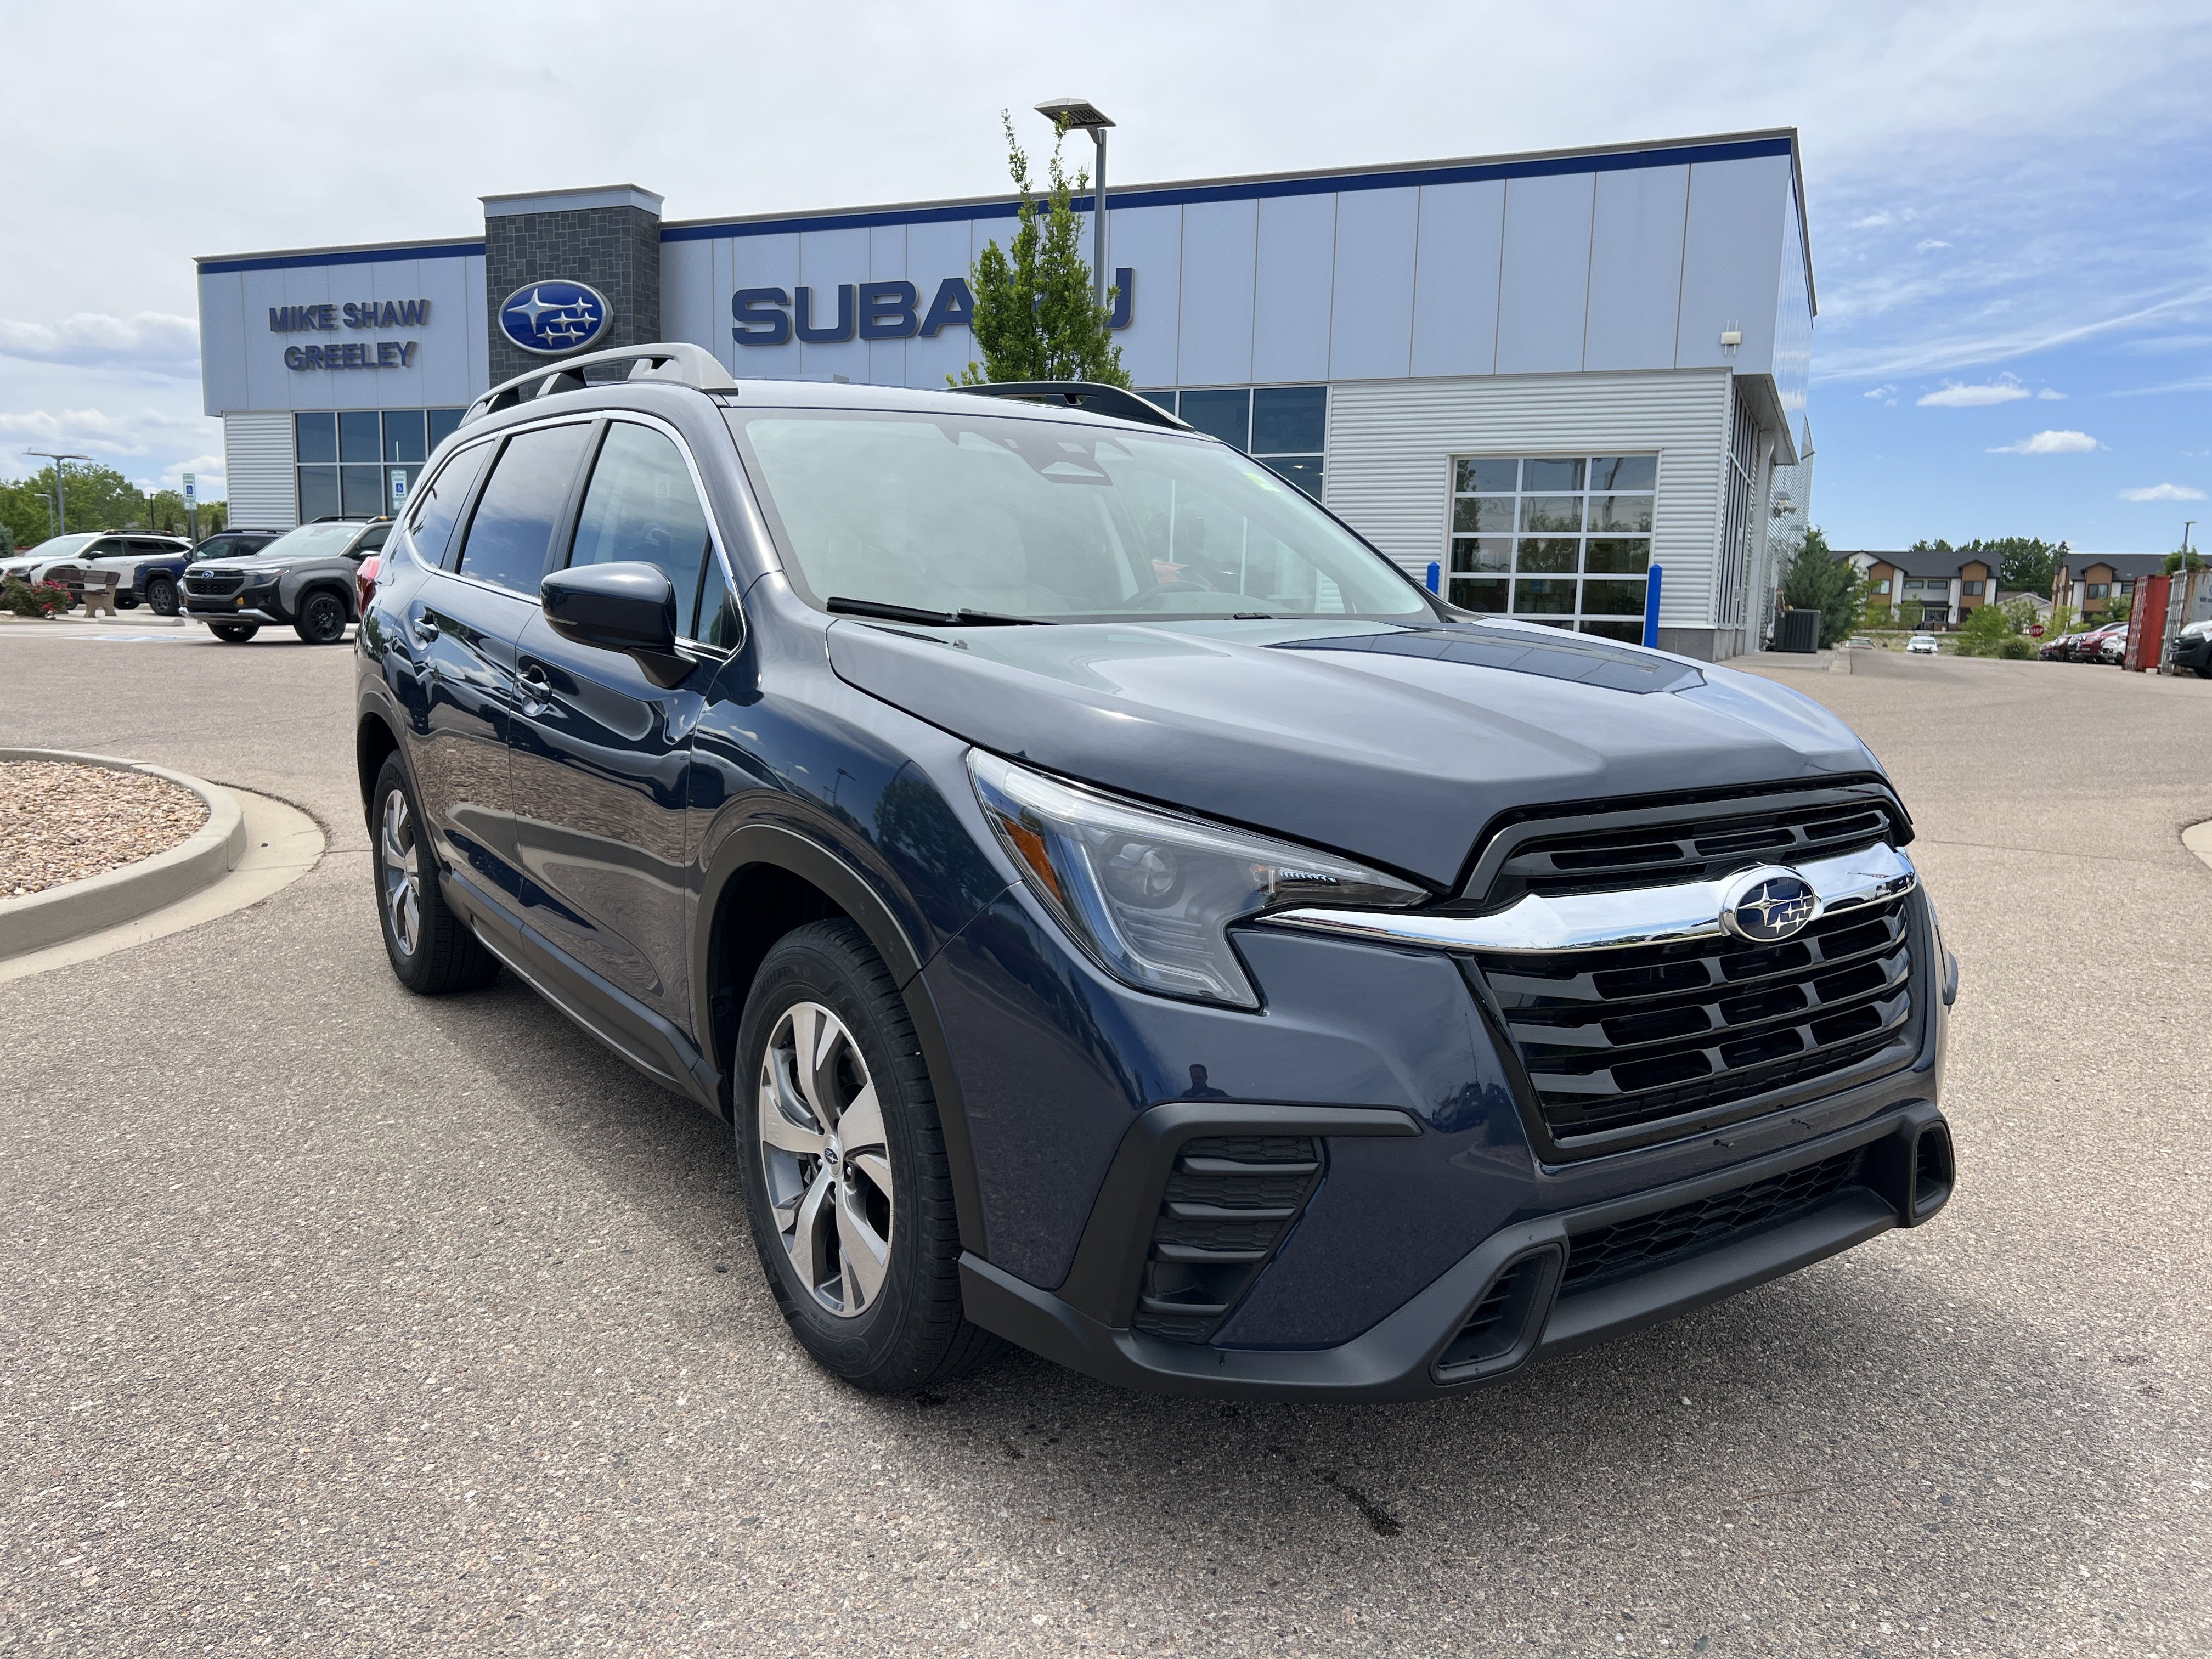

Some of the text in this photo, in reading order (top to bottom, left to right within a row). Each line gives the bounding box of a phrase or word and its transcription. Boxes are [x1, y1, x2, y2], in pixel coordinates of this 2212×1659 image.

[269, 299, 430, 331] MIKE SHAW
[732, 267, 1135, 346] SUBAU
[284, 341, 416, 370] GREELEY
